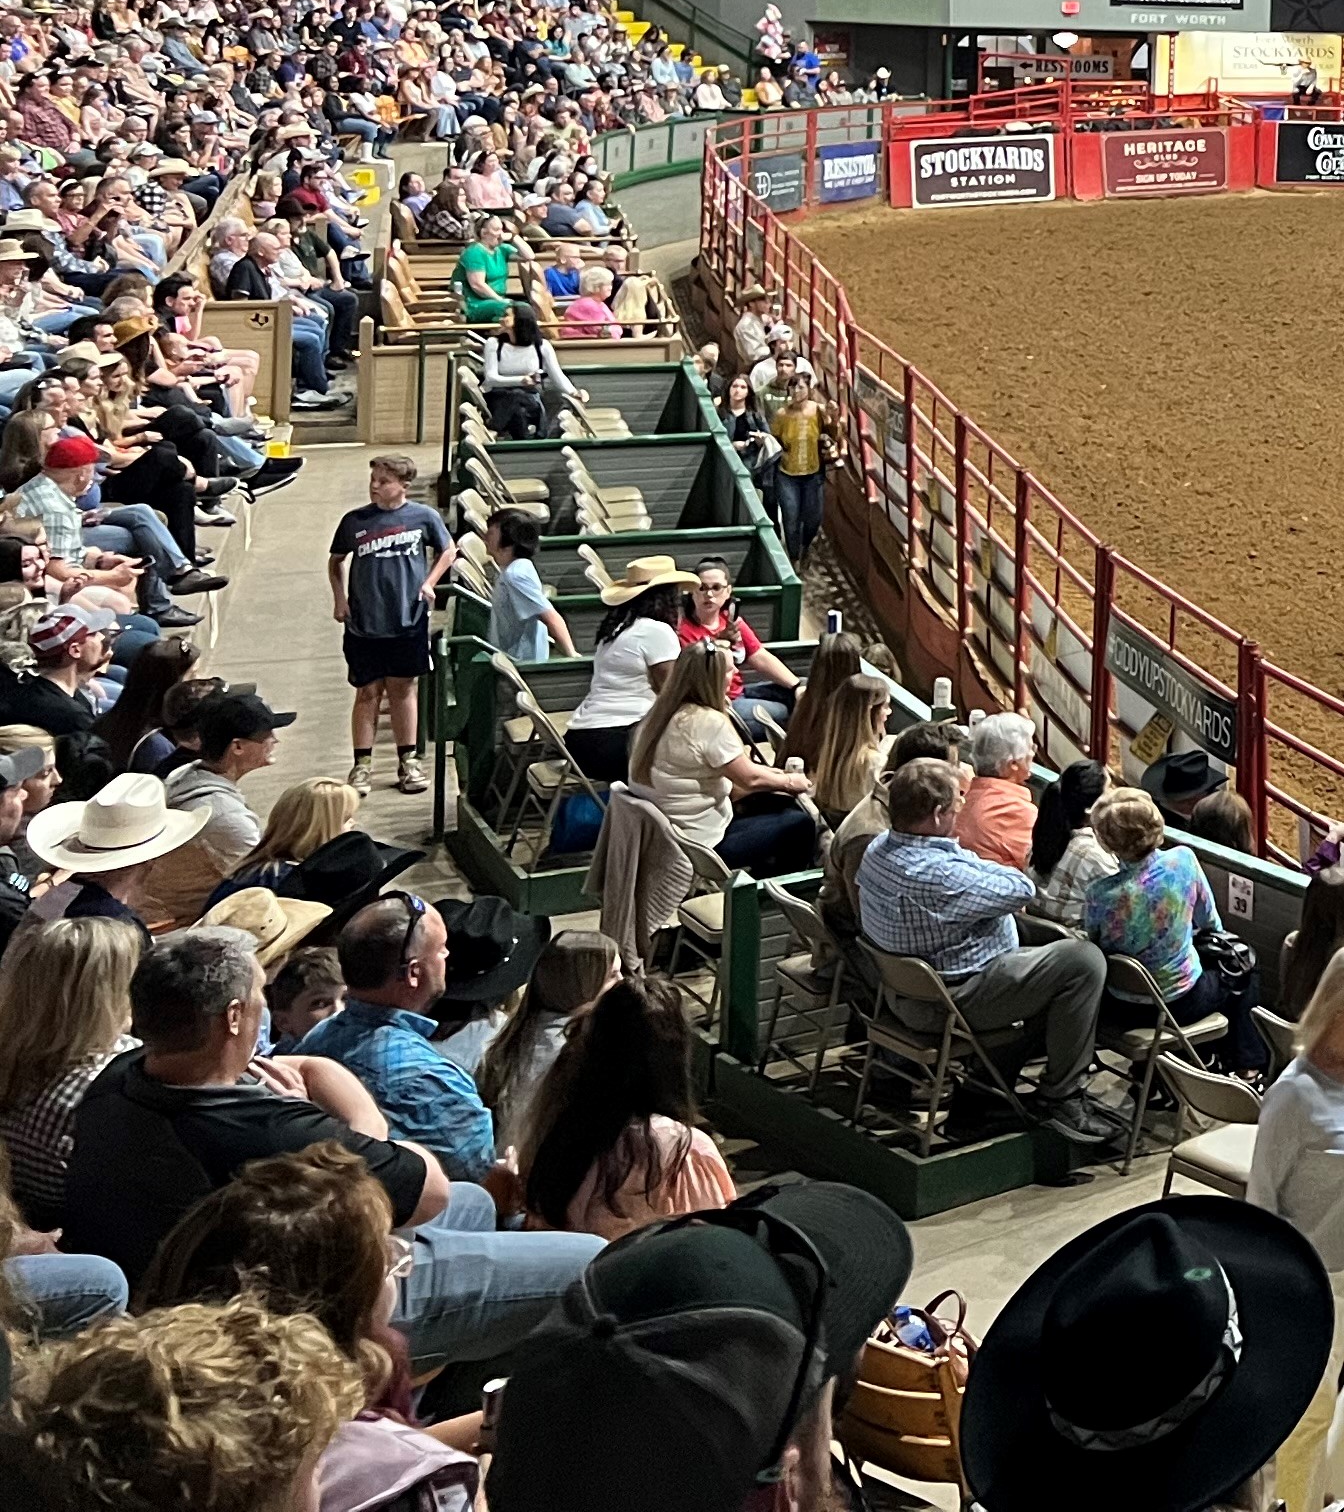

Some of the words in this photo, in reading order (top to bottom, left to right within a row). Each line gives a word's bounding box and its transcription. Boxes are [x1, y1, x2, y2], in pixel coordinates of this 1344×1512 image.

[1130, 13, 1168, 24] FORT
[1175, 14, 1226, 25] WORTH
[1233, 46, 1335, 58] STOCKYARDS
[1124, 138, 1207, 156] HERITAGE
[920, 146, 1045, 178] STOCKYARDS
[950, 173, 1016, 187] STATION
[1156, 173, 1168, 183] UP
[1169, 171, 1198, 181] TODAY
[358, 529, 422, 557] CHAMPIONS
